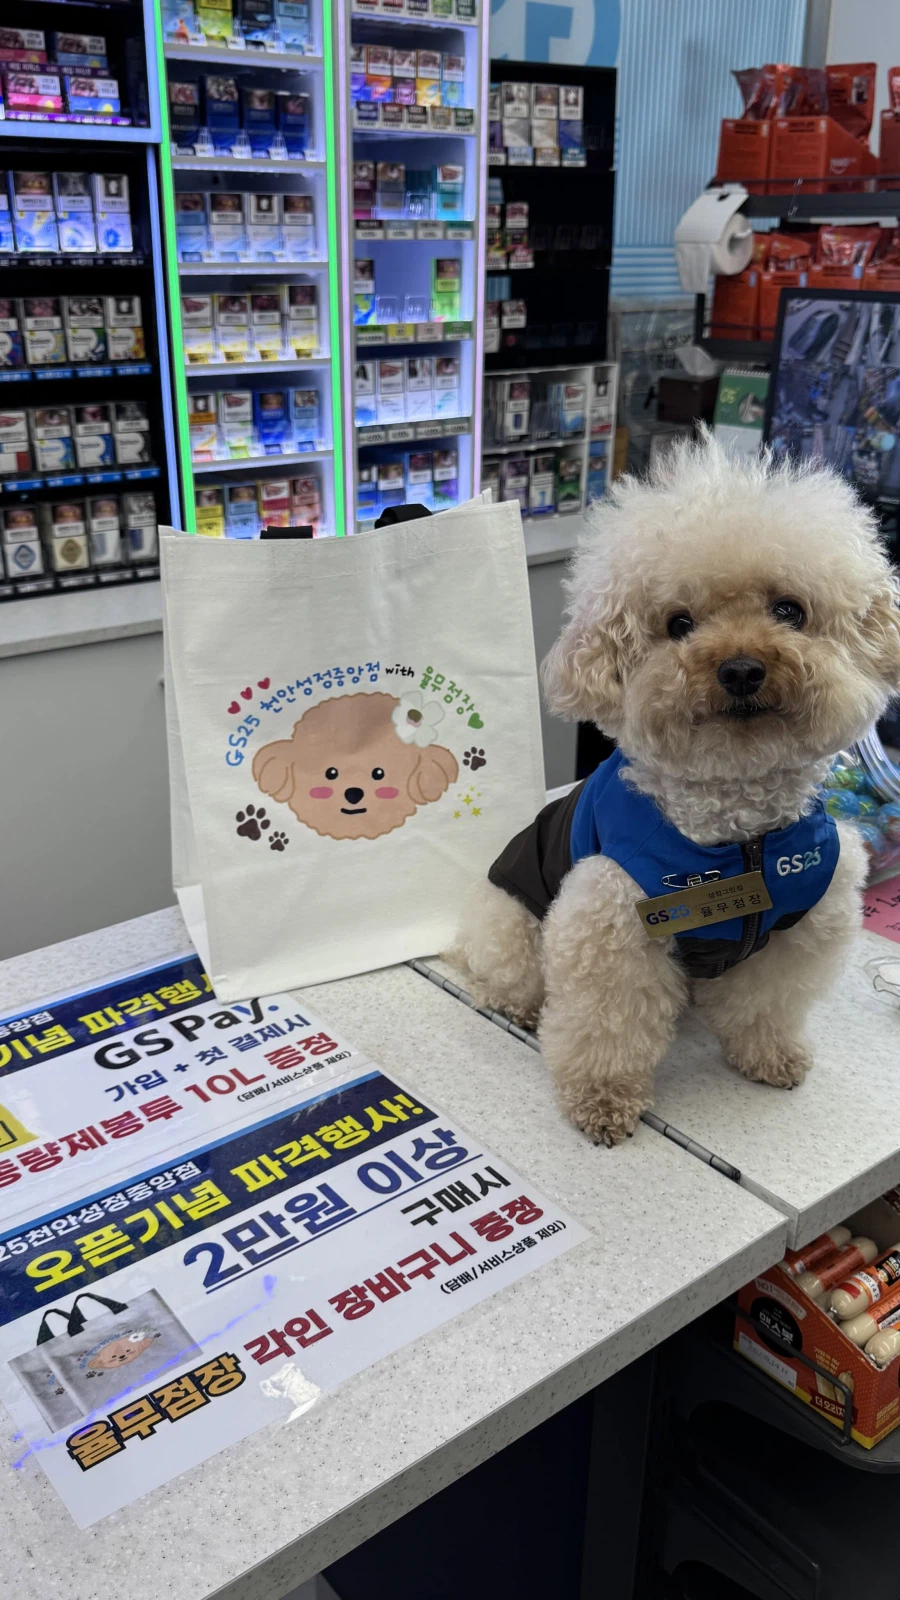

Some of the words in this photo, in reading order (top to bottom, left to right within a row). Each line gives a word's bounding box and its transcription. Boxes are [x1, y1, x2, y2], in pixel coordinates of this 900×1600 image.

[225, 714, 261, 767] GS25
[259, 661, 381, 713] 천안성정중앙점
[385, 664, 415, 678] with
[776, 846, 822, 877] GS25
[645, 904, 690, 926] GS25
[77, 972, 213, 1035] 파격행
[93, 1028, 175, 1070] GS
[105, 1069, 168, 1102] 가입
[195, 1046, 228, 1066] 첫
[228, 1013, 312, 1053] 결제시
[184, 1067, 266, 1104] 10L
[263, 1031, 339, 1071] 증정
[323, 1050, 352, 1066] 제외)
[25, 1179, 232, 1293] 오픈기념
[230, 1093, 424, 1193] 파격행사!
[183, 1182, 357, 1289] 2만원
[357, 1127, 469, 1195] 이상
[400, 1165, 511, 1227] 구매시
[440, 1234, 539, 1295] (담배/서비스상품
[535, 1219, 567, 1246] 제외)
[66, 1351, 246, 1472] 율무점장
[243, 1308, 334, 1365] 각인
[328, 1231, 477, 1321] 장바구니
[469, 1194, 544, 1243] 증정
[823, 1400, 847, 1418] 오리지
